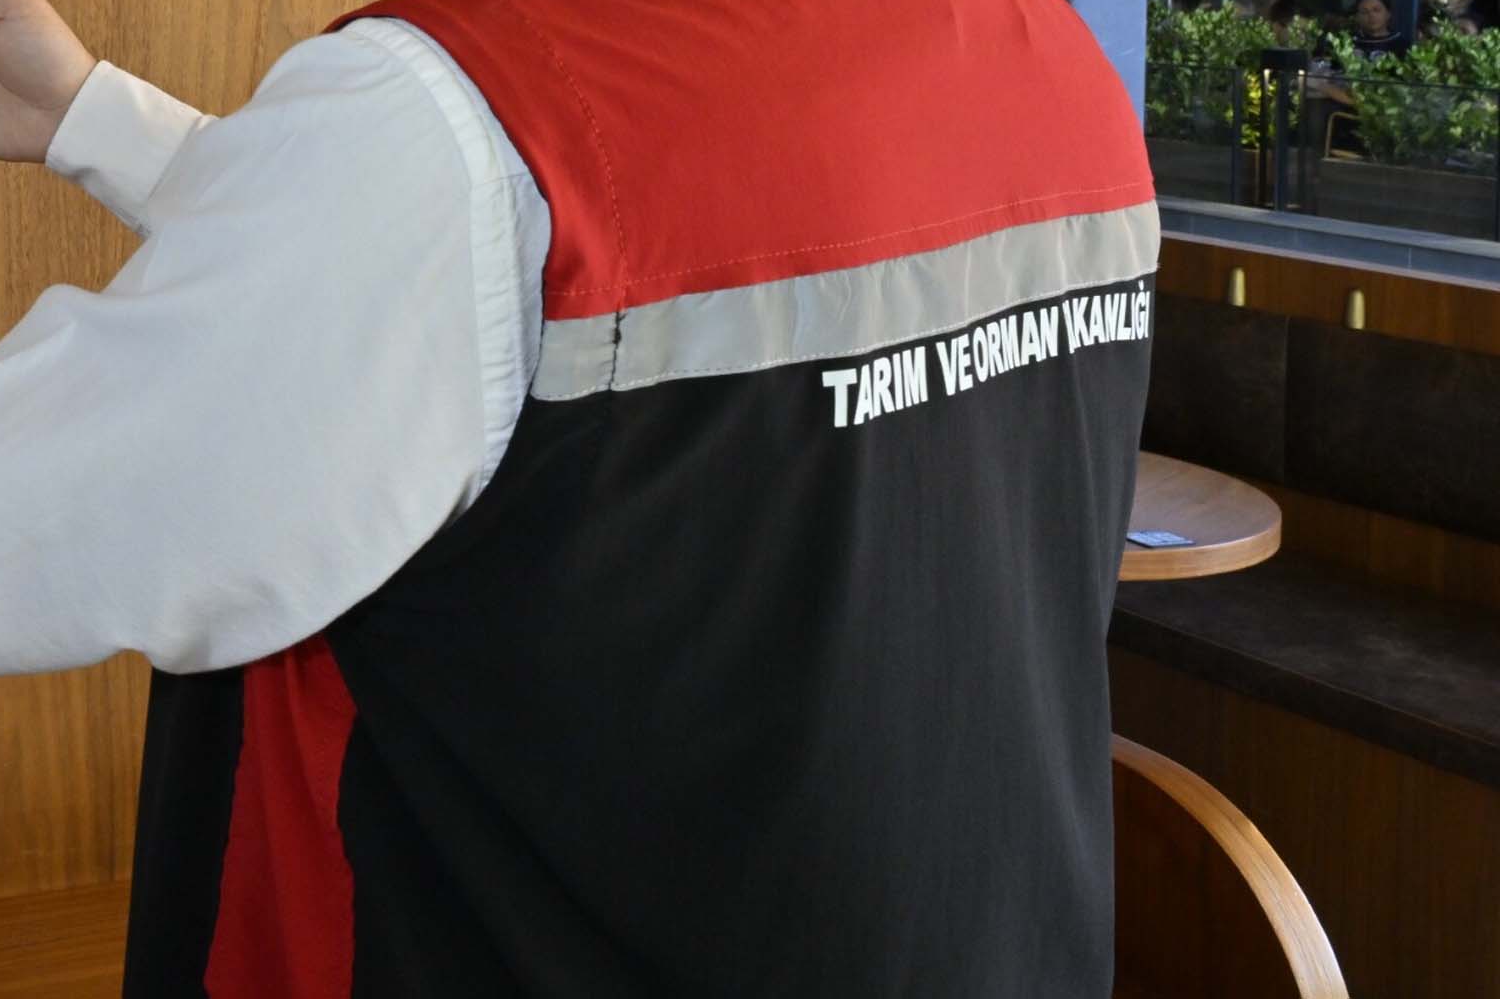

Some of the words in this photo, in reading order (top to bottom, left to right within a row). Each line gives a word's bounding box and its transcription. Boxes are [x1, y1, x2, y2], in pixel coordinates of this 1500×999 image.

[822, 345, 929, 428] TARIM
[935, 332, 974, 396] VE
[973, 305, 1059, 382] ORMAN
